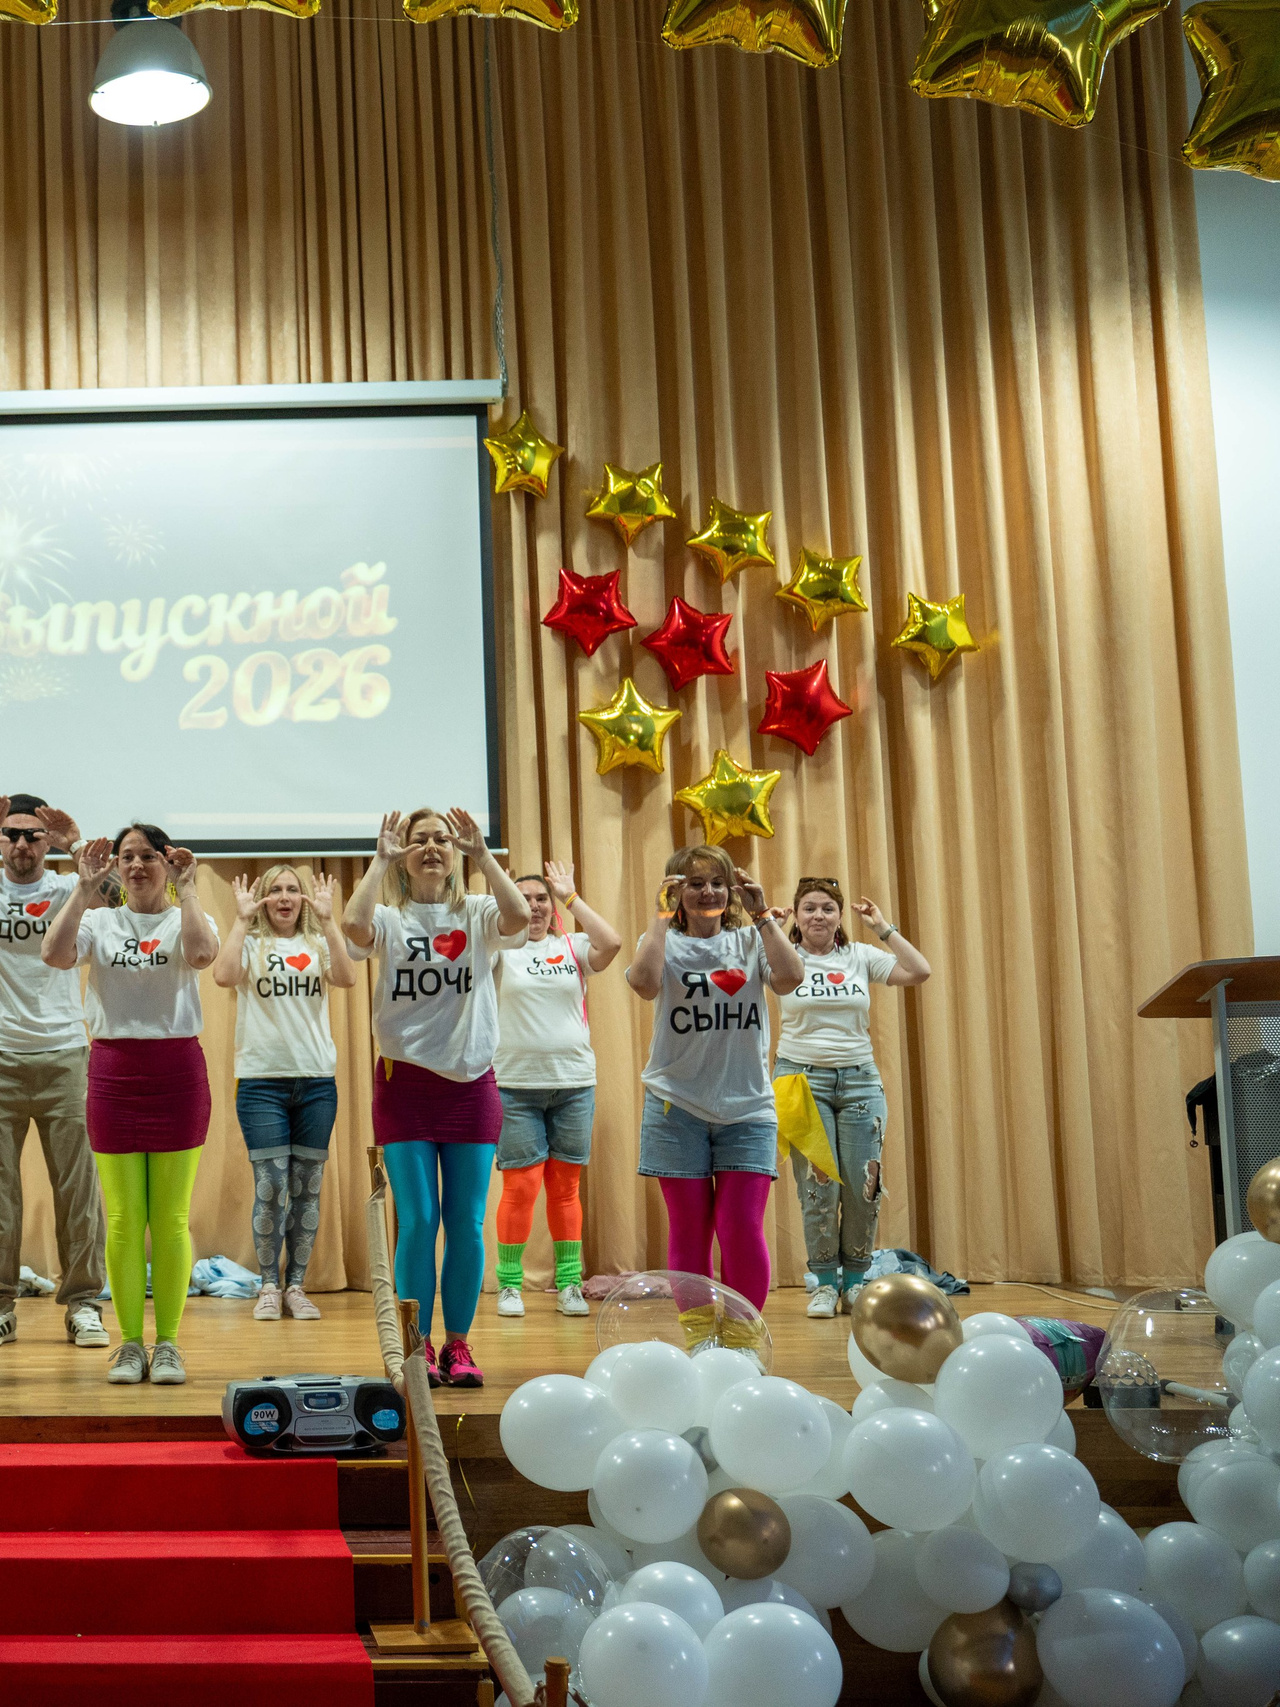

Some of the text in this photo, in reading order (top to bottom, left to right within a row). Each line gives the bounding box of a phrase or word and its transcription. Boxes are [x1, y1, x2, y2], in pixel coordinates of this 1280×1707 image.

[179, 644, 391, 731] 2026
[7, 902, 24, 916] Я
[122, 938, 139, 955] Я
[405, 936, 432, 962] Я
[111, 951, 168, 968] ДОЧЬ
[267, 953, 285, 972] Я
[256, 975, 321, 999] СЫНА
[681, 971, 710, 1000] Я
[811, 972, 825, 985] Я
[795, 983, 866, 998] СЫНА
[669, 1001, 762, 1035] СЫНА
[253, 1410, 276, 1419] 90W
